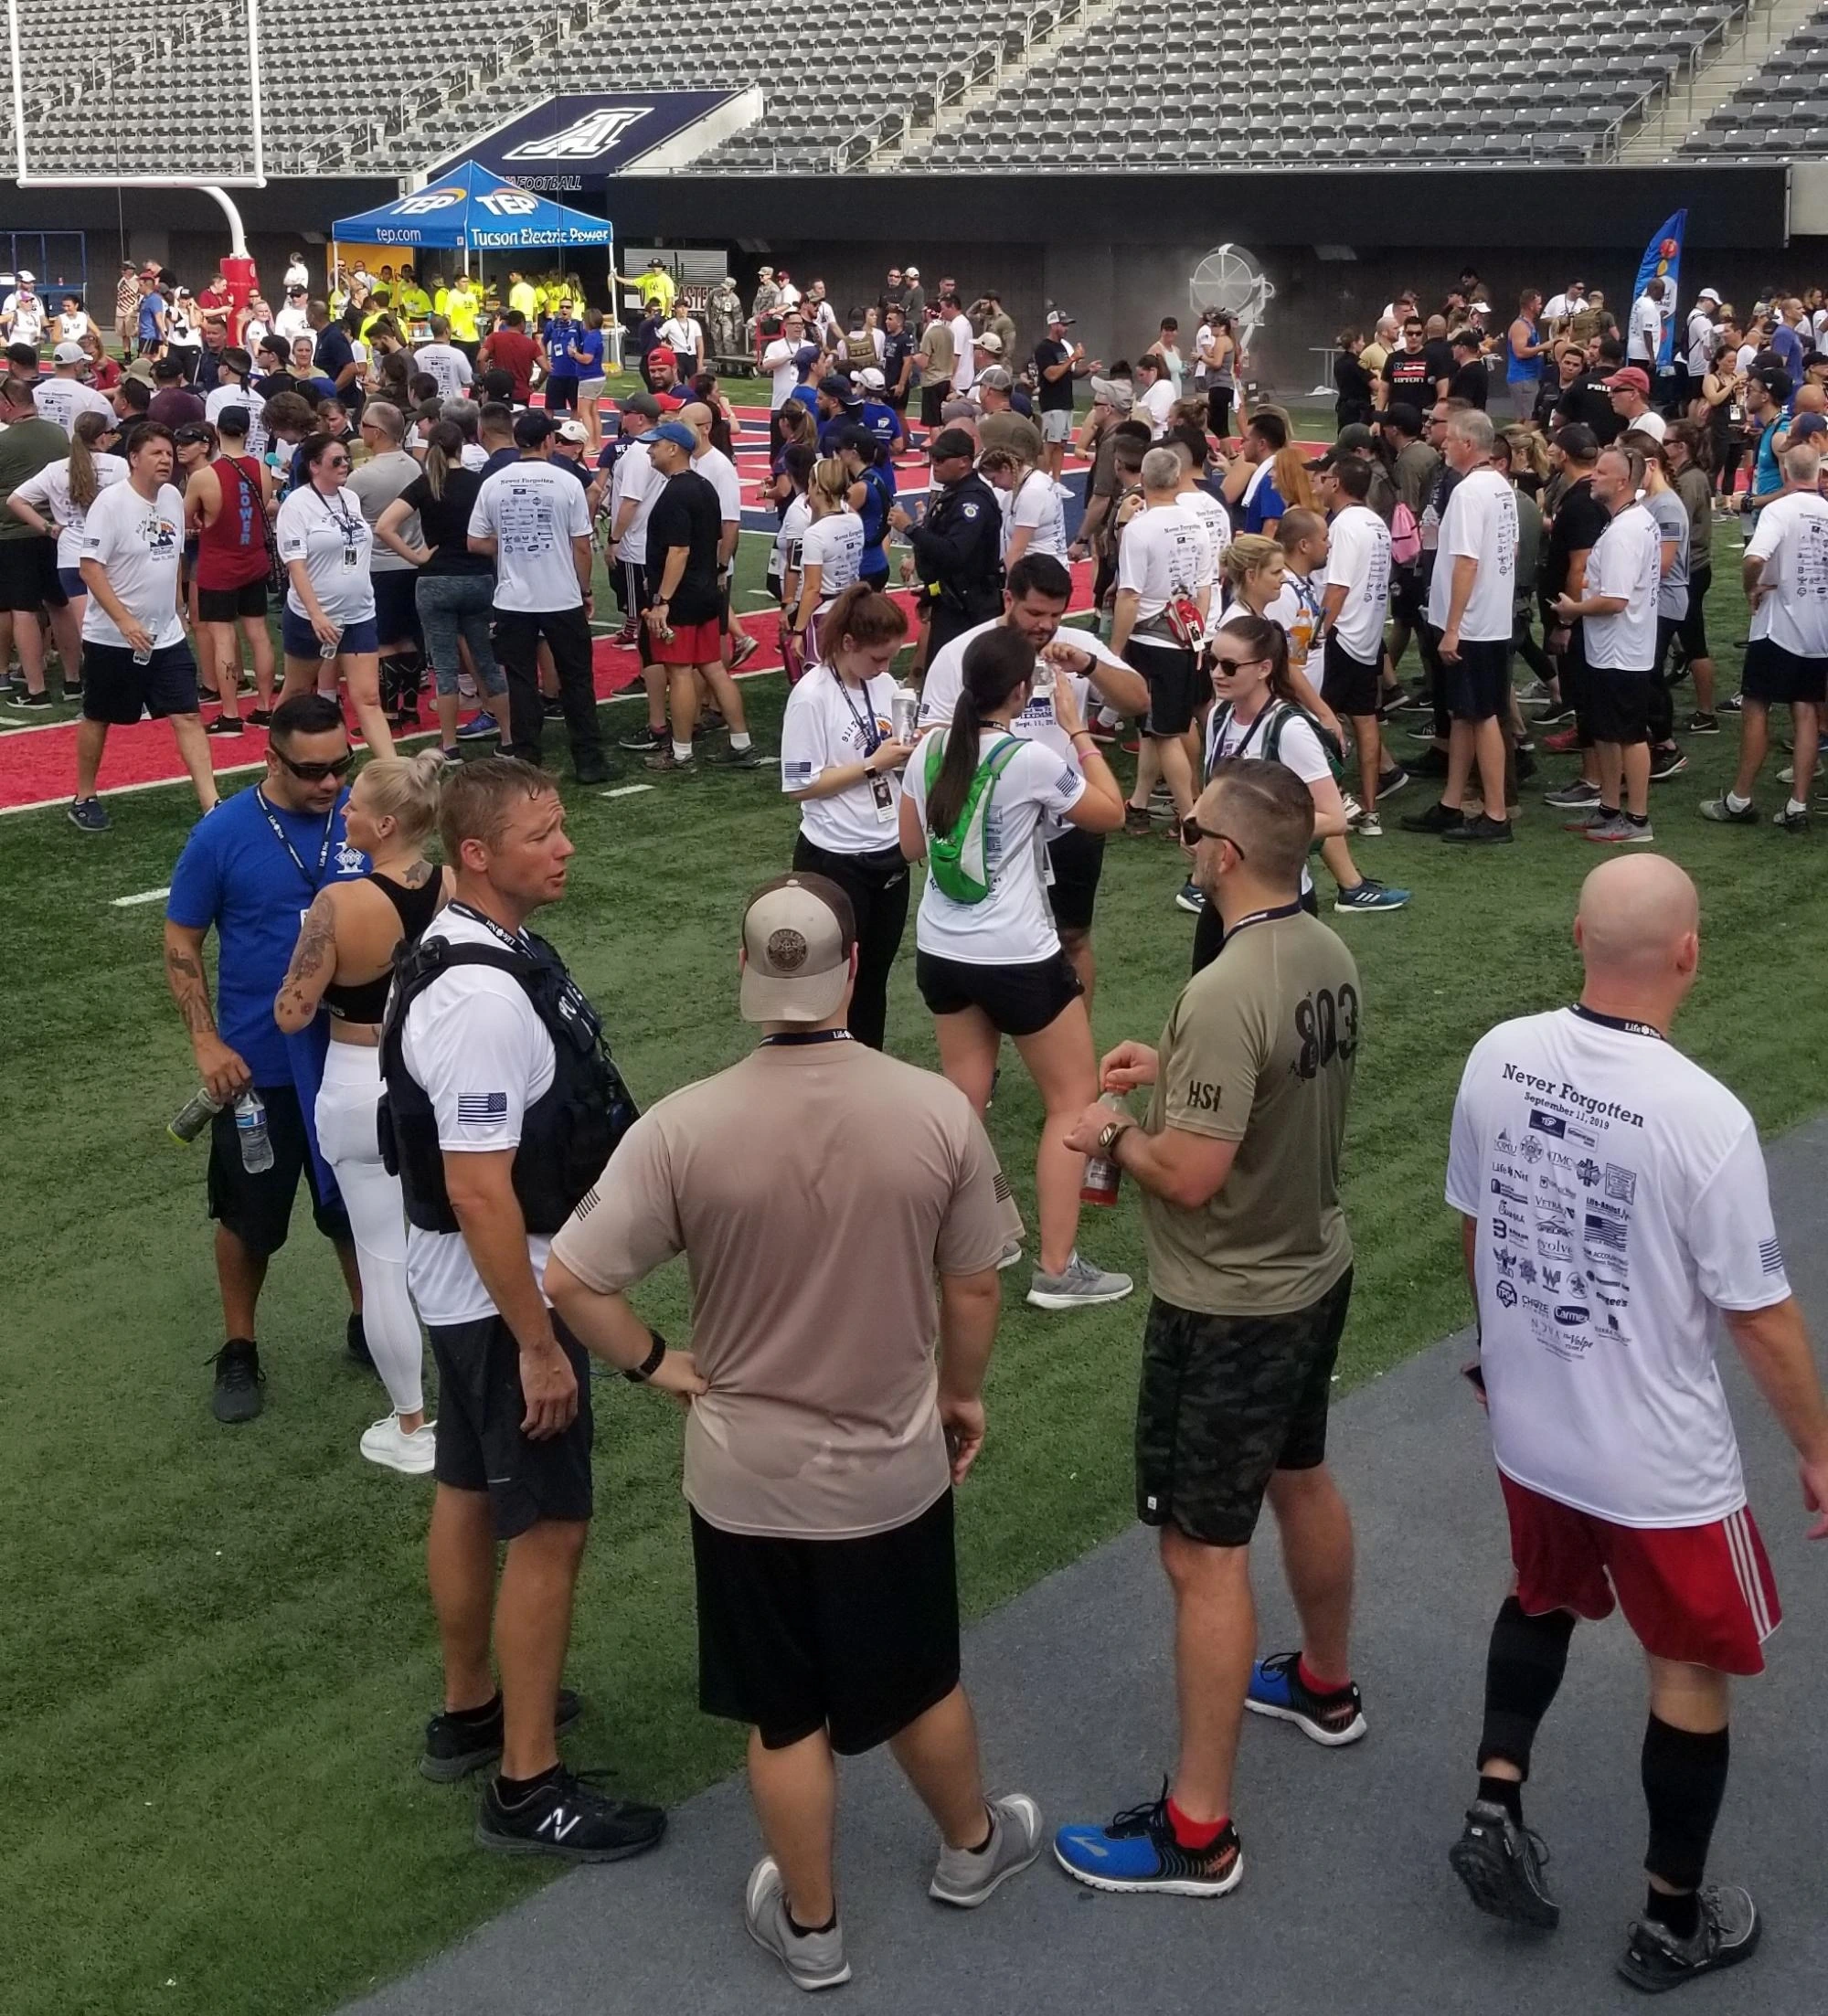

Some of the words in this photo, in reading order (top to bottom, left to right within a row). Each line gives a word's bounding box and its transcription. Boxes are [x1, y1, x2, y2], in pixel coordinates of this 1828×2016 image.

[502, 107, 655, 160] A
[517, 175, 582, 191] FOOTBALL
[389, 196, 454, 216] TEP
[475, 196, 537, 216] TEP
[377, 228, 421, 244] tep.com
[471, 228, 518, 246] Tucson
[521, 228, 567, 245] Electric
[569, 228, 609, 242] Power
[1587, 384, 1611, 392] POLI
[239, 482, 253, 546] ROWER
[1294, 982, 1358, 1079] 803
[1624, 1023, 1642, 1034] Life
[1188, 1078, 1222, 1113] HSI
[1503, 1064, 1556, 1094] Never
[1558, 1083, 1644, 1128] Forgotten
[1524, 1091, 1574, 1117] September
[1576, 1112, 1589, 1125] 11,
[1589, 1116, 1610, 1130] 2019
